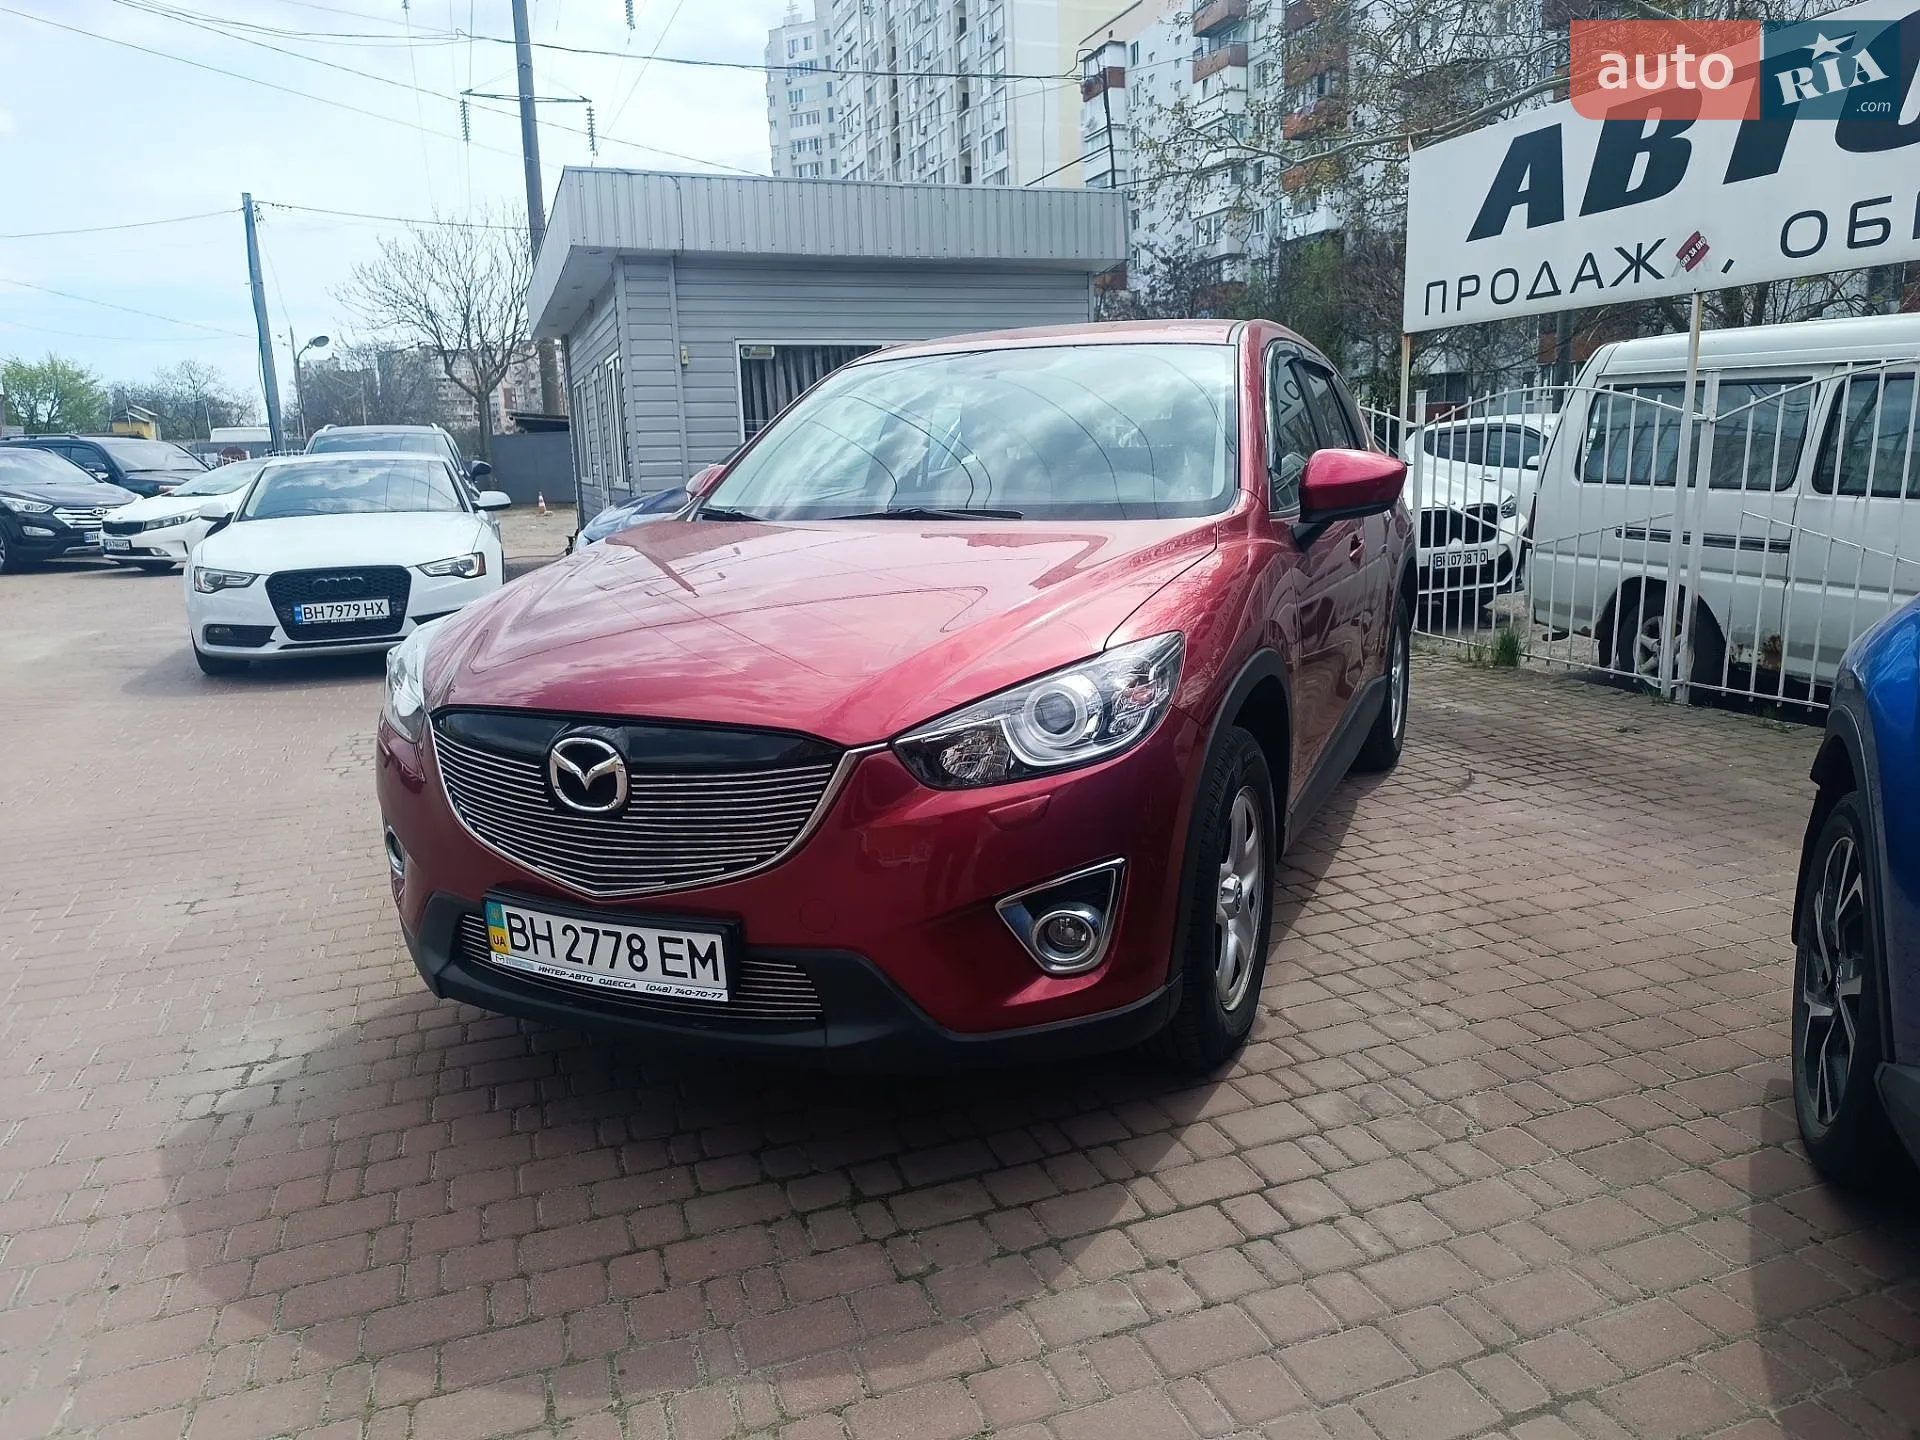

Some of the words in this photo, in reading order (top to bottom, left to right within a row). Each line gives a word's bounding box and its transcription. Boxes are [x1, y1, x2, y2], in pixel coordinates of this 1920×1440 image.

[1780, 191, 1920, 258] ОБ
[303, 606, 325, 620] BH
[327, 604, 360, 618] 7979
[364, 602, 385, 616] HX
[493, 935, 506, 946] UA
[505, 912, 556, 959] BH
[561, 924, 648, 972] 2778
[657, 935, 720, 982] EM
[538, 966, 594, 982] ИНТЕР-АВТО
[598, 976, 636, 989] ОДЕССА
[646, 983, 672, 994] (048)
[674, 988, 724, 999] 740-70-77
